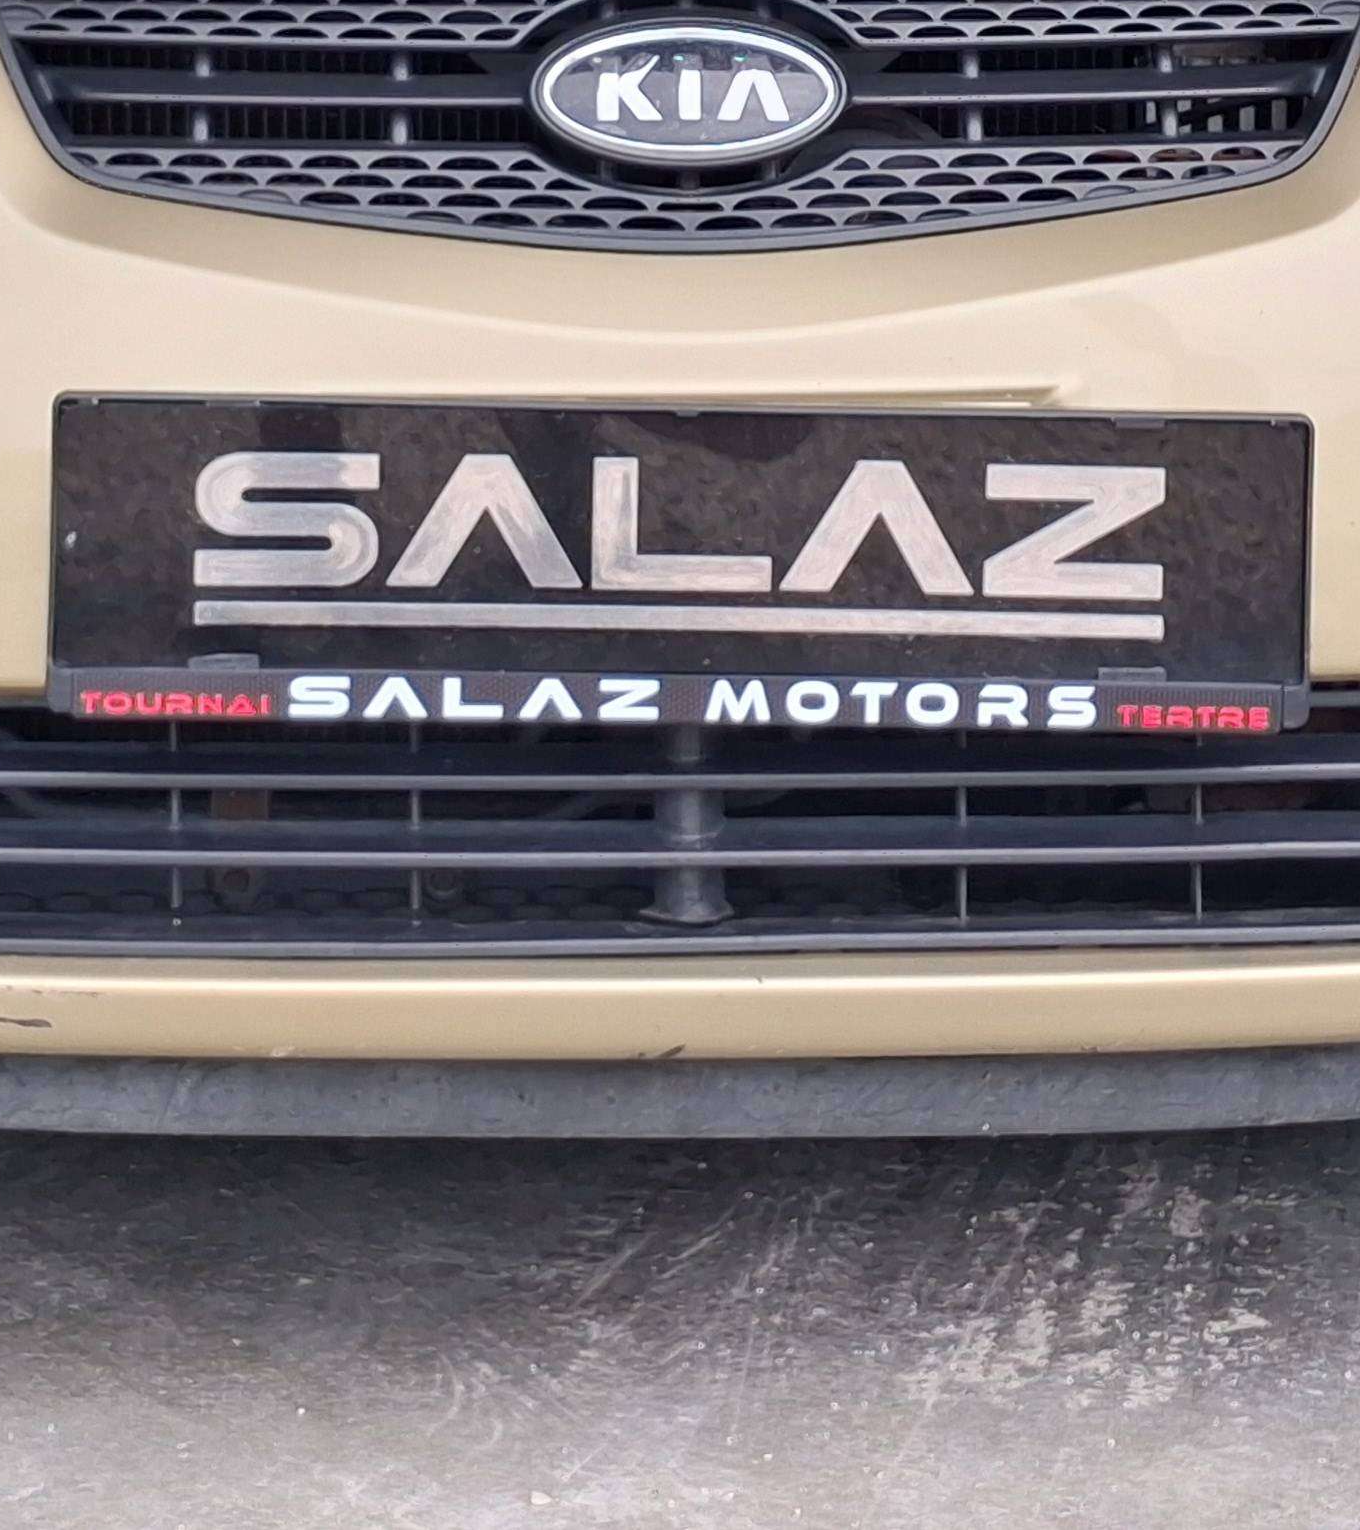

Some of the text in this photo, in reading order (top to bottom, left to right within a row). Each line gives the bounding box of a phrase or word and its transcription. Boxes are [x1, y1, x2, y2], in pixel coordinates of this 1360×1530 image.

[595, 54, 790, 121] KIA
[193, 451, 1166, 601] SALAZ
[80, 690, 272, 717] TOURNAI
[287, 675, 661, 722] SALAZ
[703, 678, 1097, 730] MOTORS
